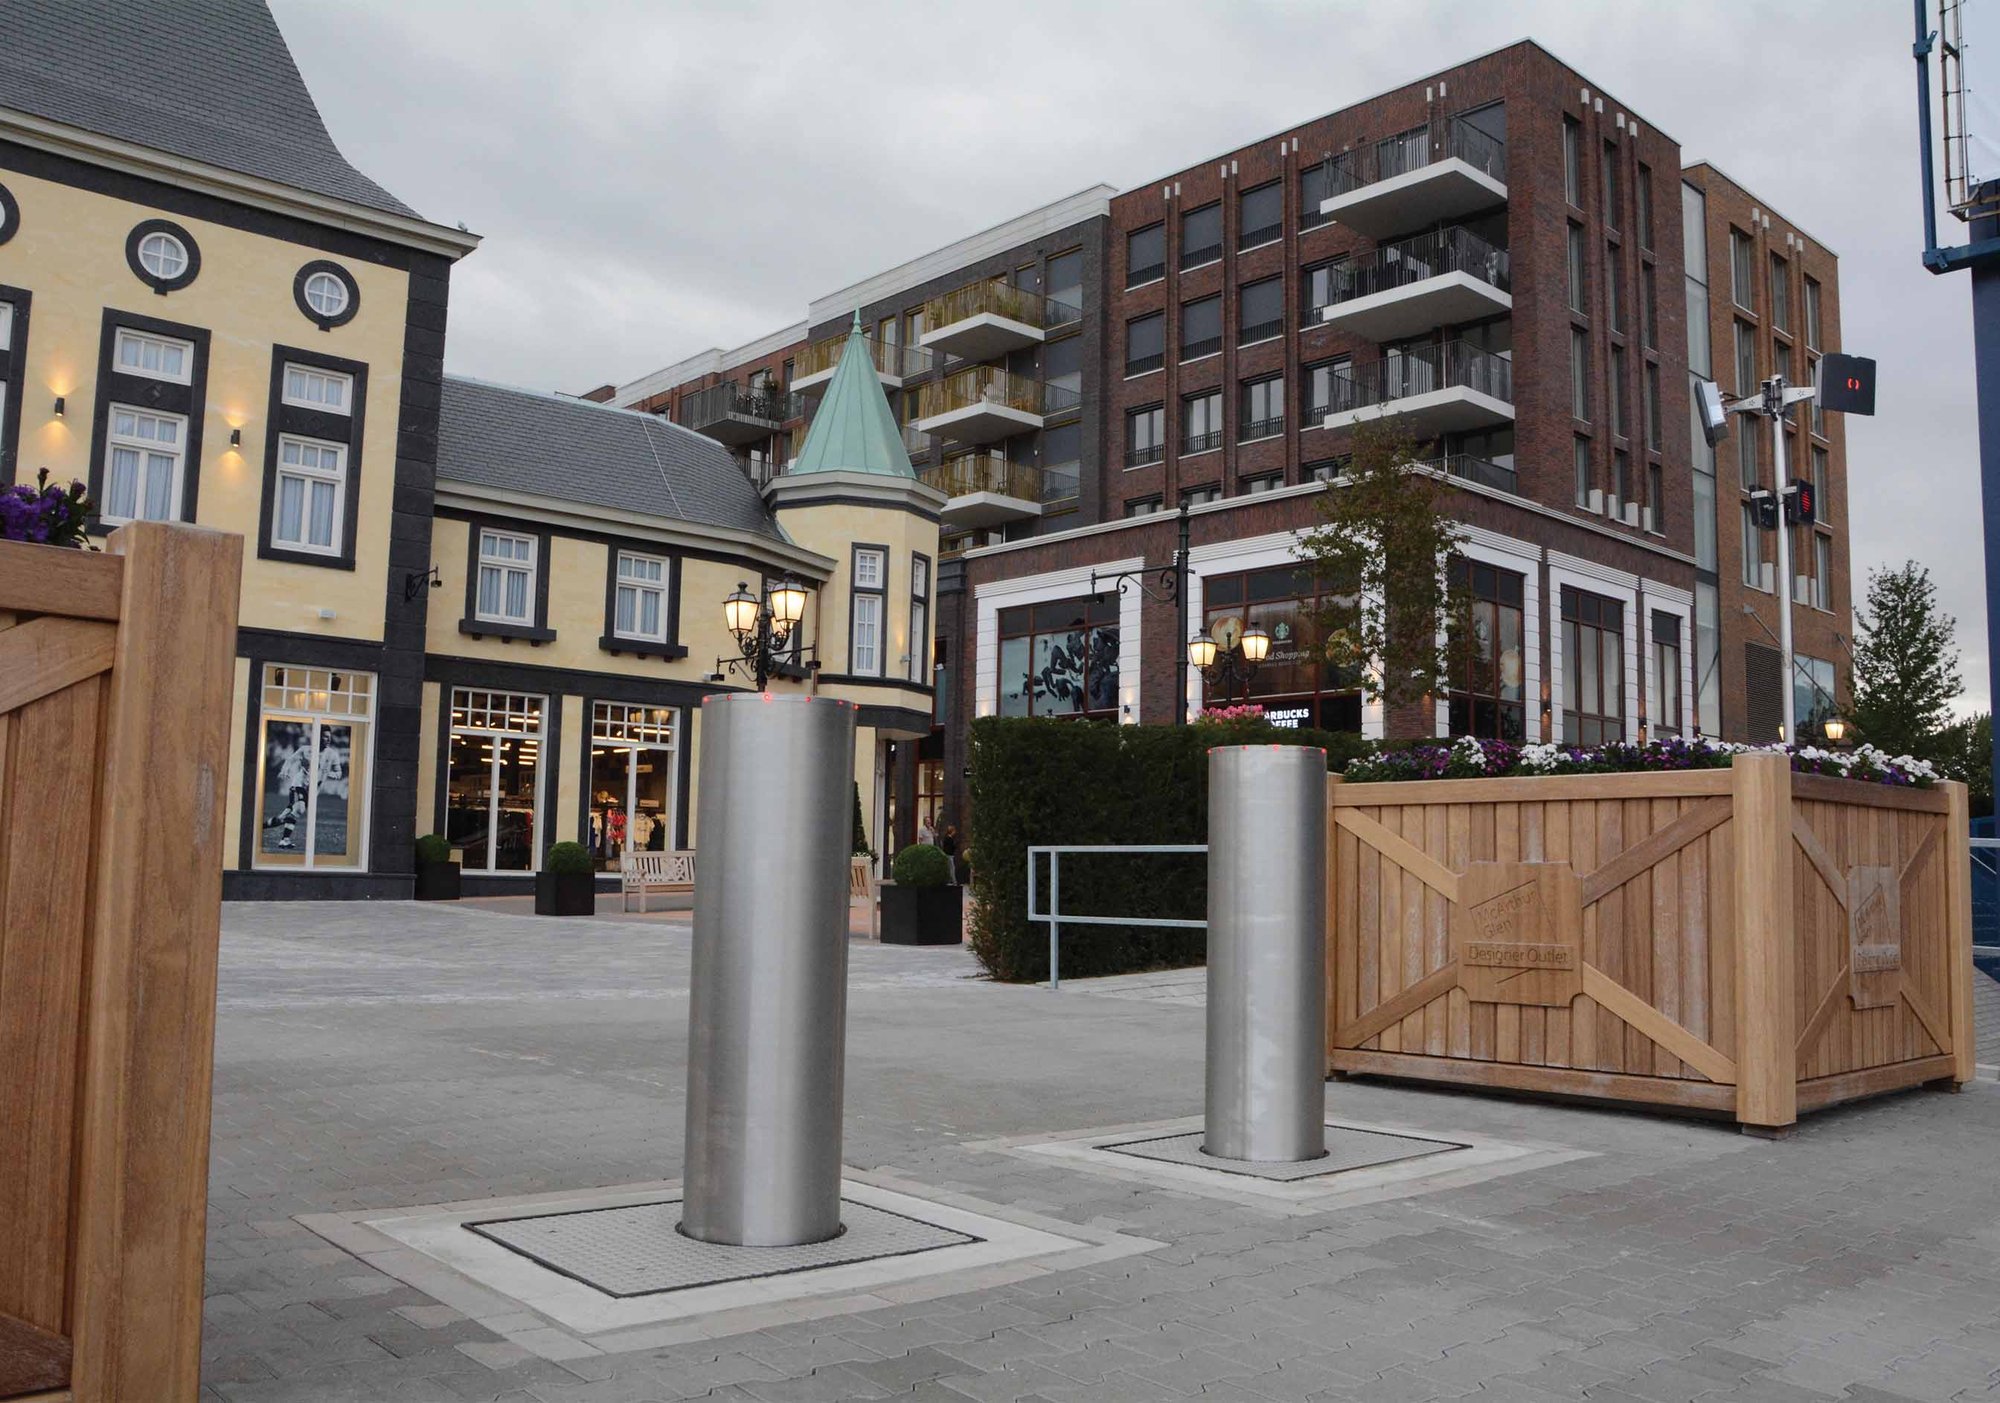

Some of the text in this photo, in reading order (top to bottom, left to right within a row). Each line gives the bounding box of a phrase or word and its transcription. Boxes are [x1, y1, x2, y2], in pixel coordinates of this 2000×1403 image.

[1264, 708, 1310, 720] ARBUCKS
[1482, 919, 1513, 939] Glen
[1468, 946, 1568, 964] Designer Outlet
